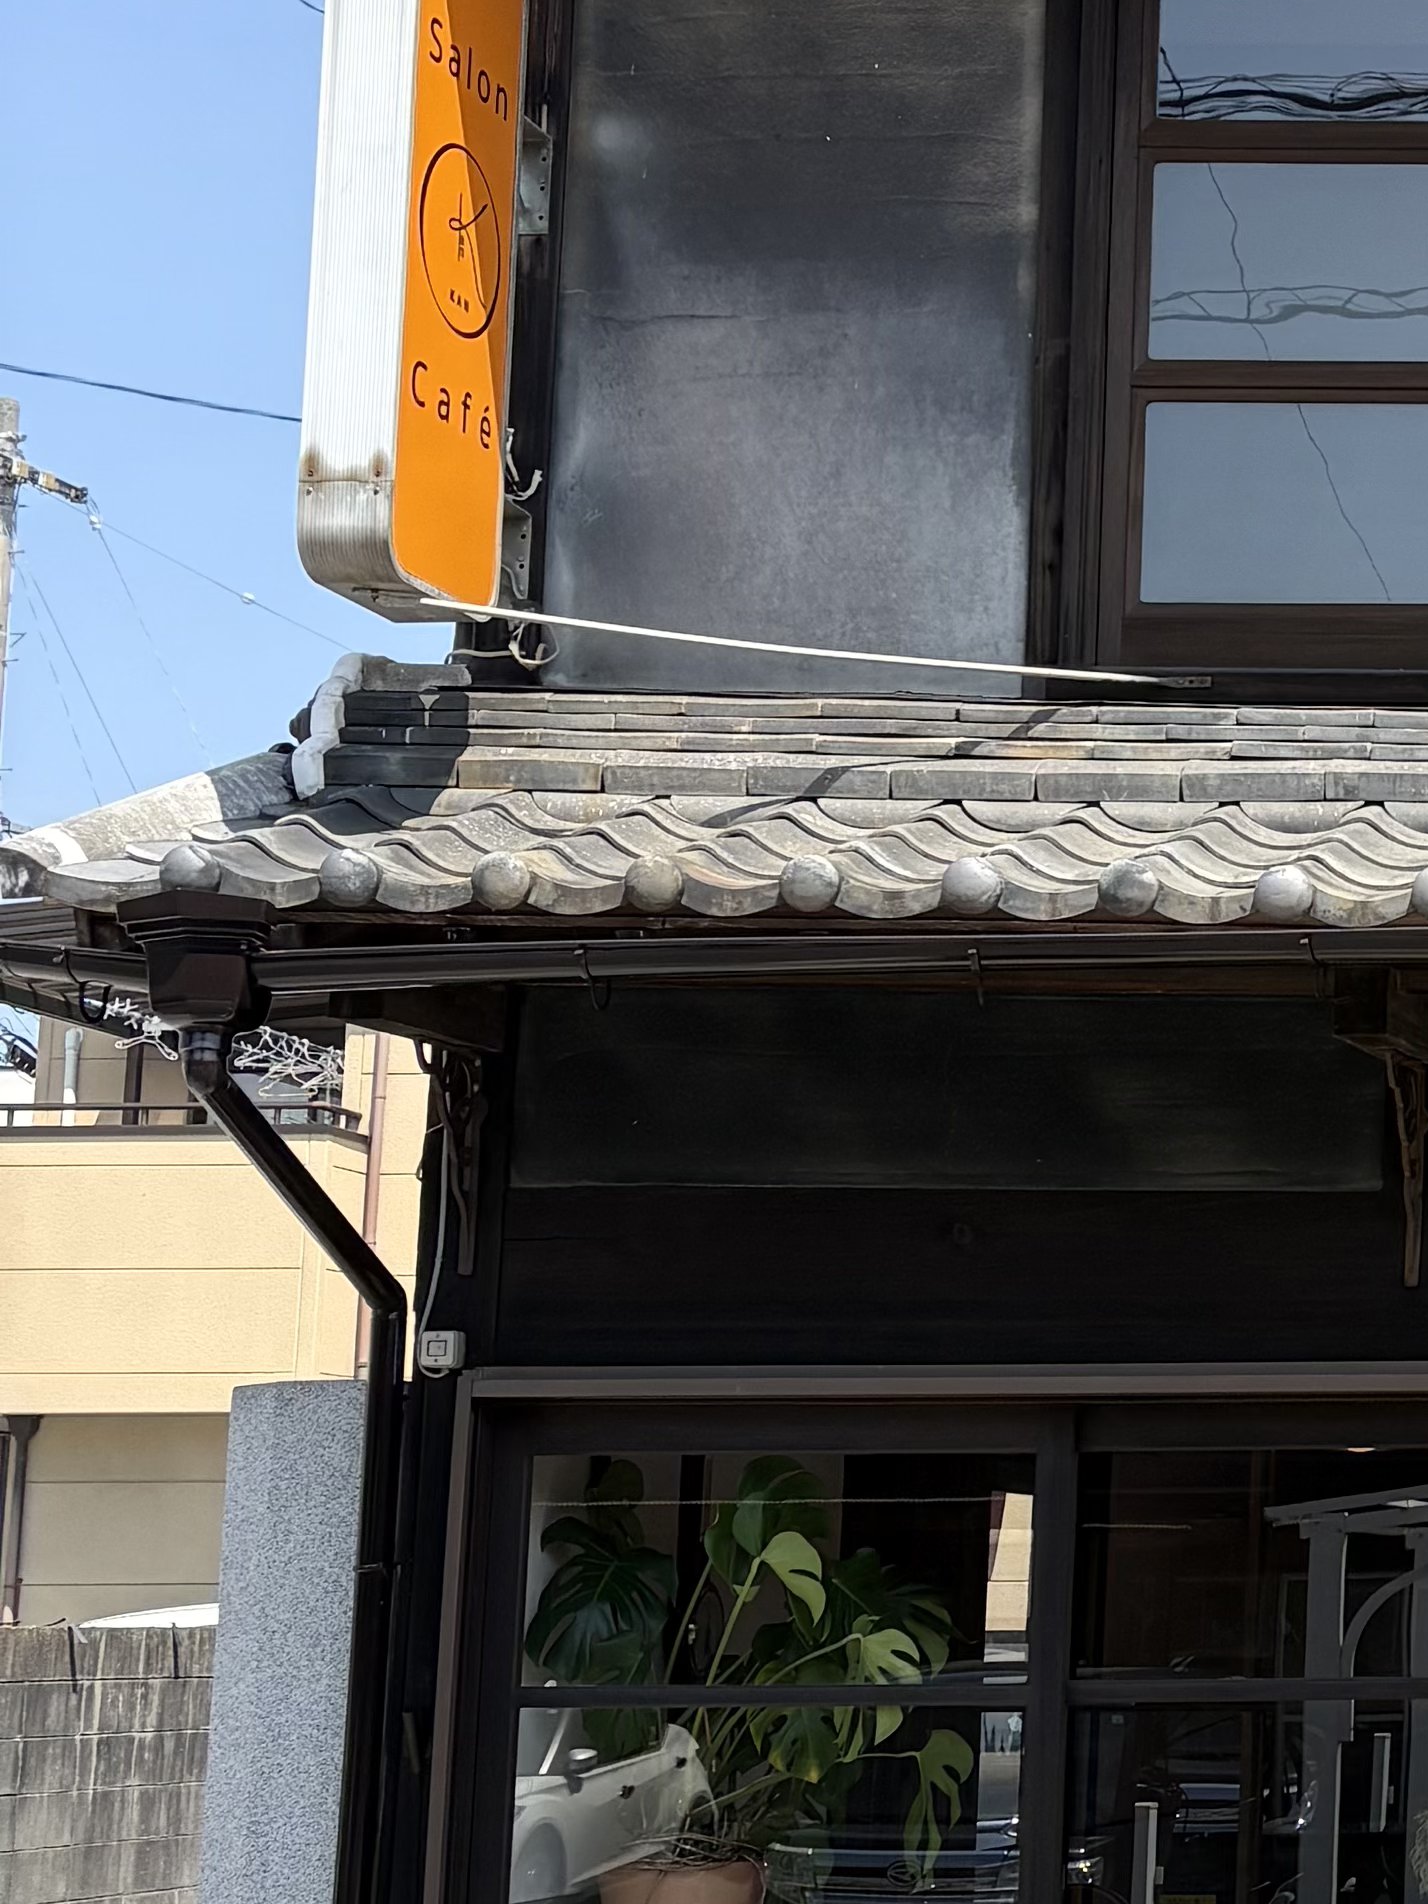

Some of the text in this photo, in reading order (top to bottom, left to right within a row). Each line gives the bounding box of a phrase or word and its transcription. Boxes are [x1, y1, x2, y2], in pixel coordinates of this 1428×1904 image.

[428, 17, 508, 122] Salon
[449, 287, 470, 314] KAN
[411, 360, 492, 450] Café
